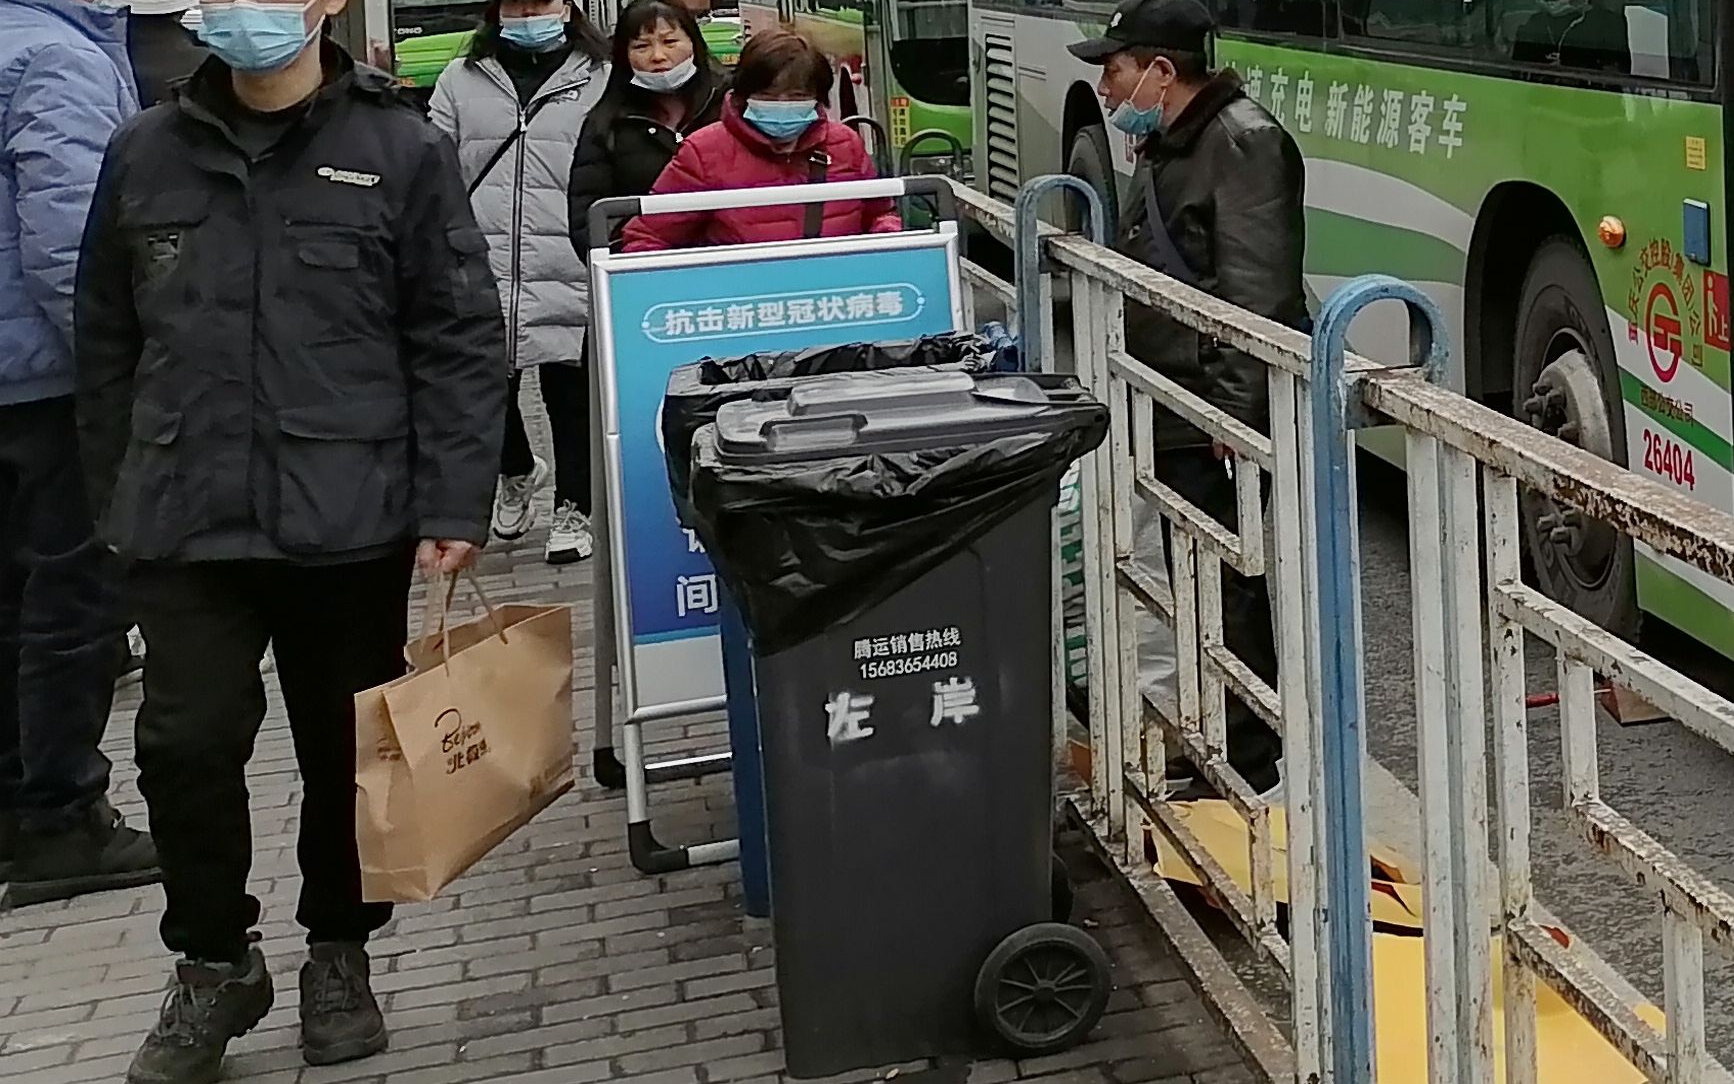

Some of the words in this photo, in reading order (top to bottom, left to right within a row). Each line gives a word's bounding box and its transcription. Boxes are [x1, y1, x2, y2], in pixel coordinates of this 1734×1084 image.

[1225, 60, 1314, 133] 速充电
[1325, 80, 1467, 159] 新能源客车
[665, 291, 902, 335] 抗击新型冠状病毒
[1643, 427, 1695, 491] 26404
[854, 627, 961, 659] 腾运销售热线
[860, 652, 957, 679] 15683654408
